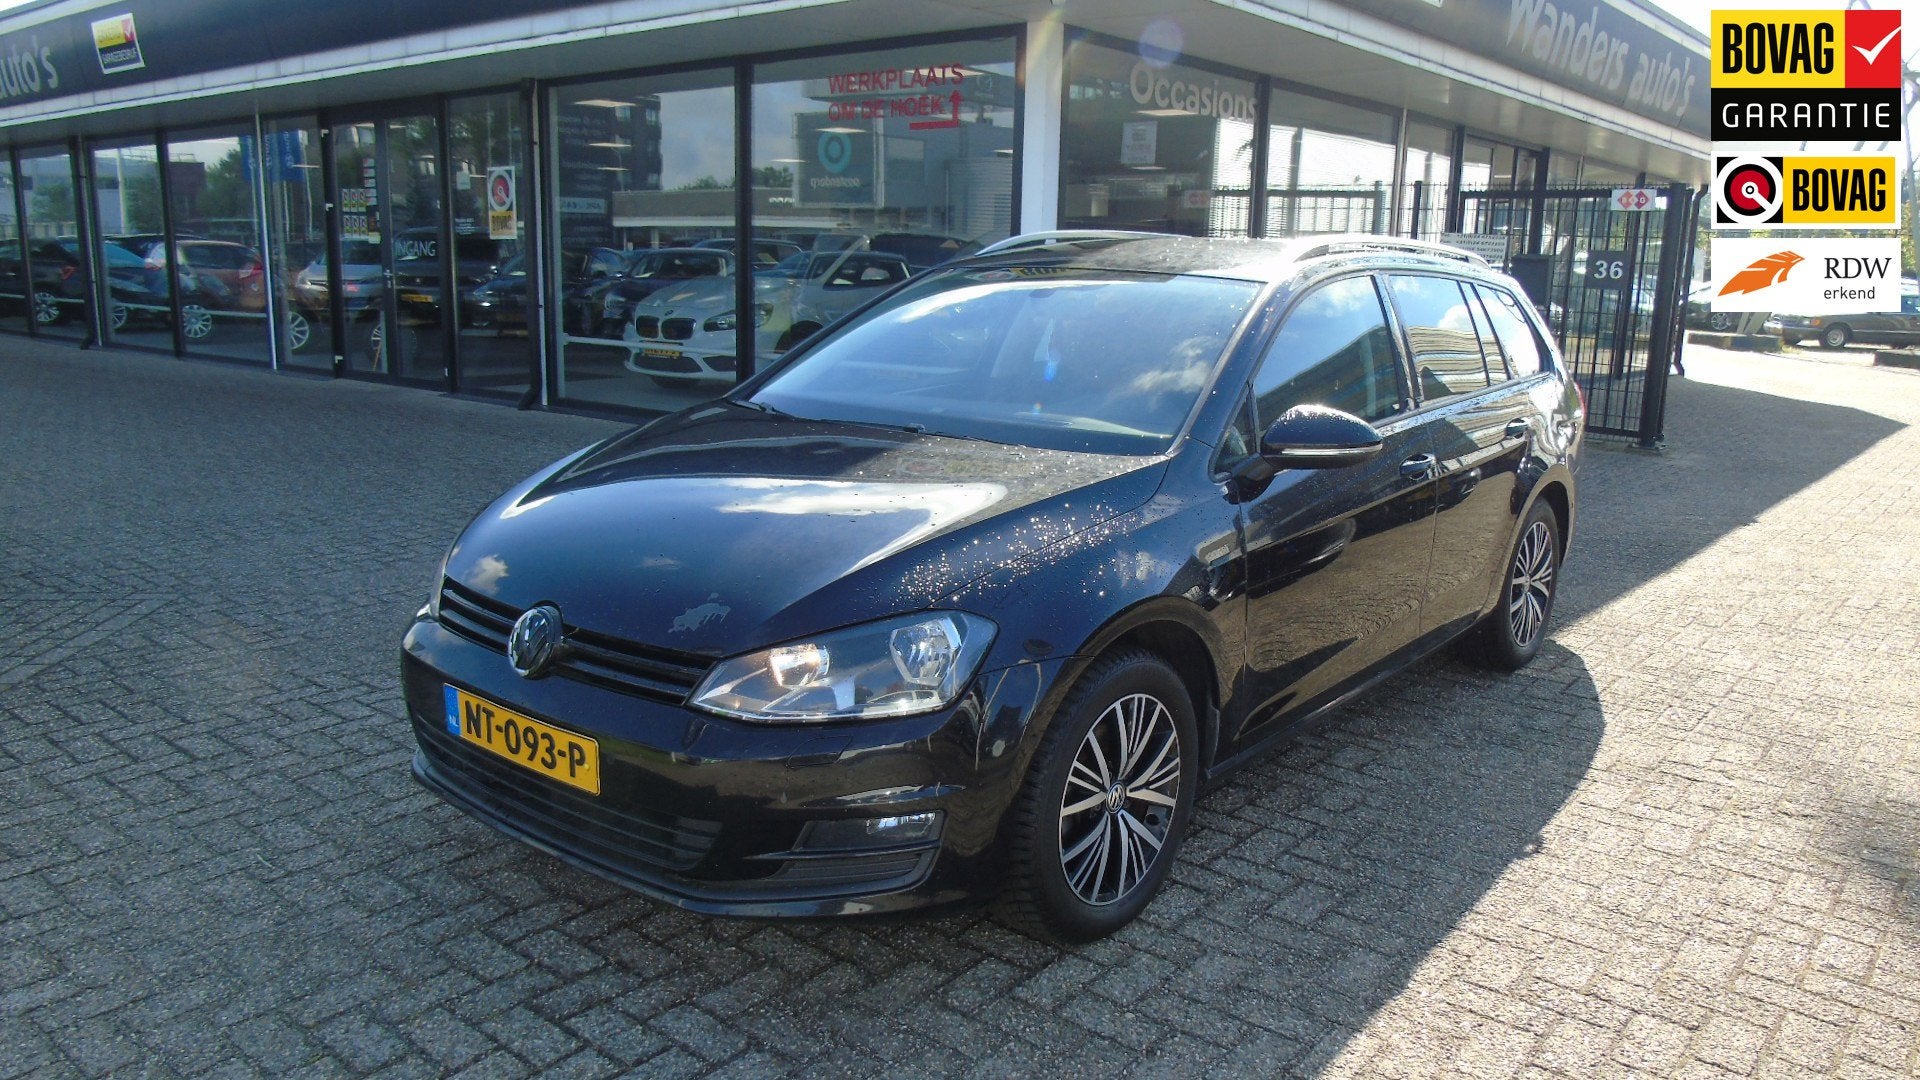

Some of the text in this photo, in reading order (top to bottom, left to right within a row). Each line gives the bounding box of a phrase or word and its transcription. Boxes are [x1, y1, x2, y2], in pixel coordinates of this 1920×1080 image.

[827, 62, 966, 95] WERKPLAATS
[1505, 0, 1696, 117] Wanders auto's
[828, 94, 947, 122] OM DE HOEK
[1130, 60, 1257, 122] Occasions
[1594, 260, 1624, 279] 36
[465, 700, 586, 778] NT-093-P
